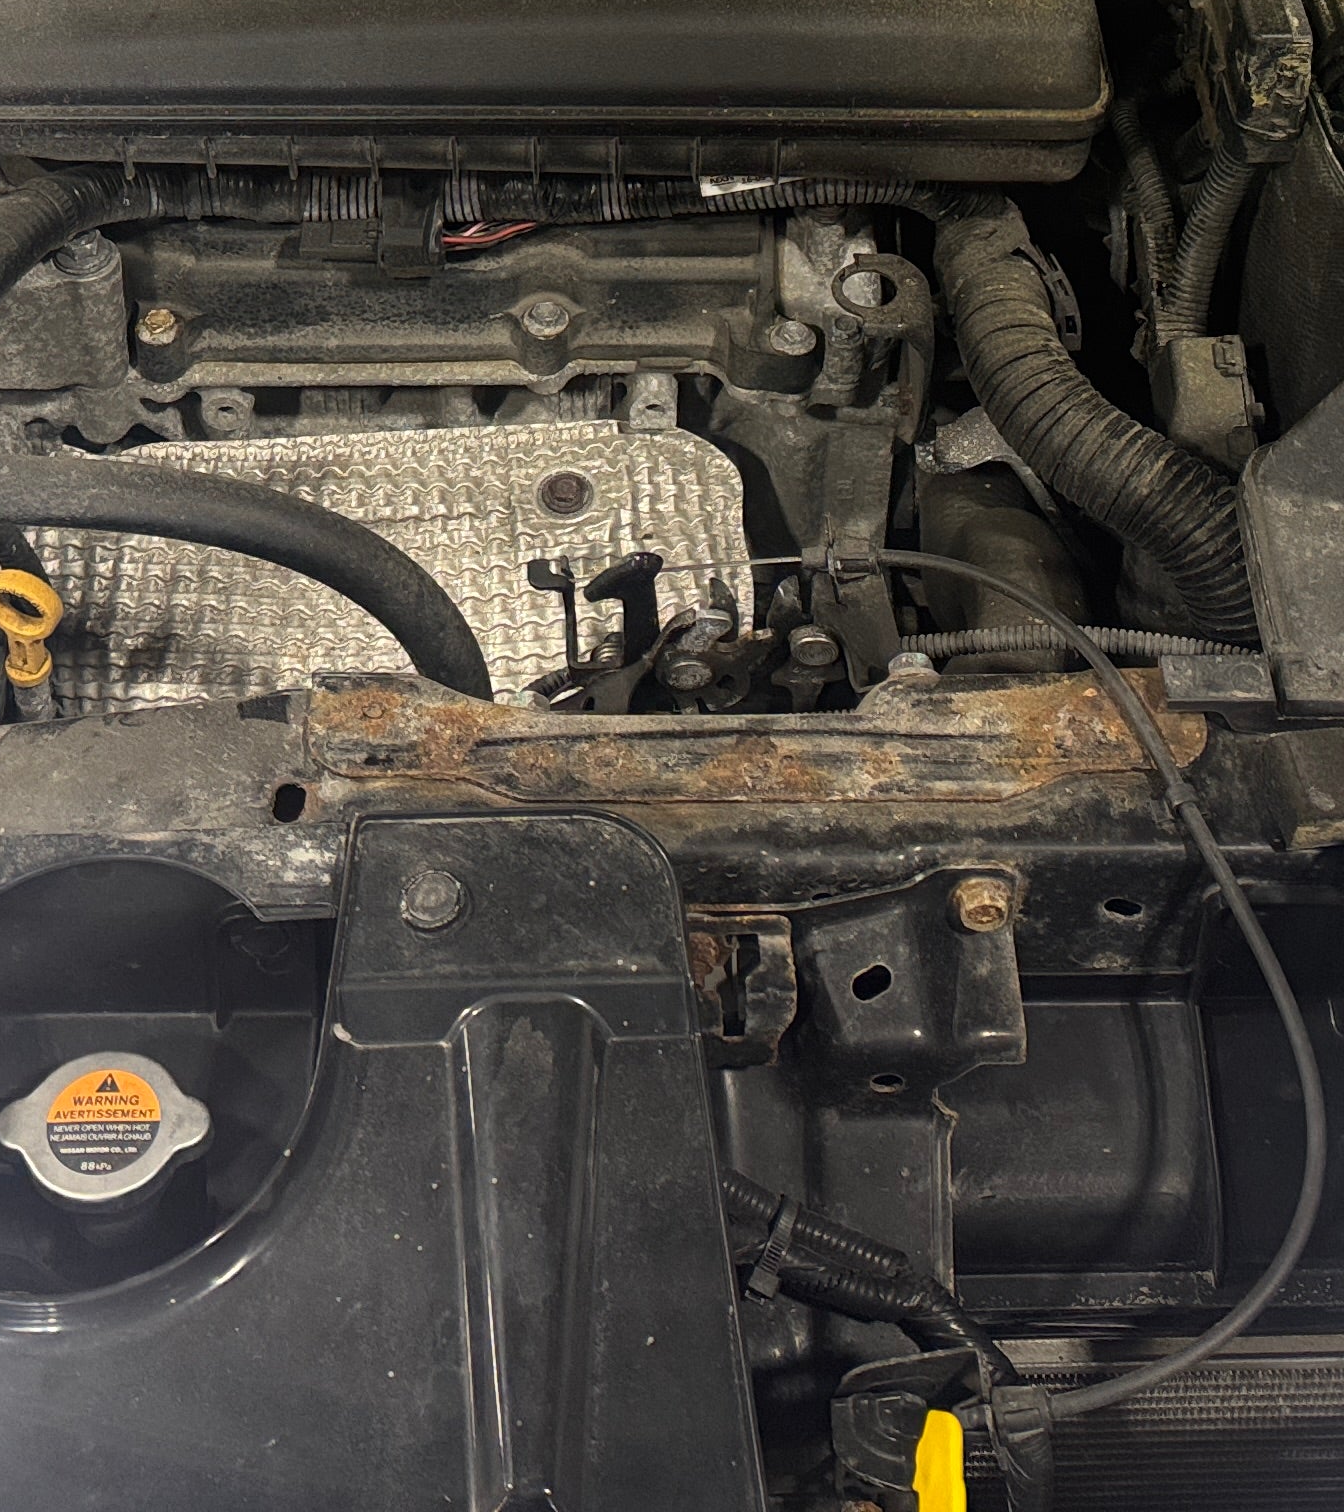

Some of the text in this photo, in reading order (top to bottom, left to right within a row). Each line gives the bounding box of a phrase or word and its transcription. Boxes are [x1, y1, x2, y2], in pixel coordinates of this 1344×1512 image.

[72, 1094, 140, 1107] WARNING
[54, 1108, 156, 1120] AVERTISSEMENT
[53, 1124, 81, 1132] NEVER
[81, 1124, 105, 1132] OPEN
